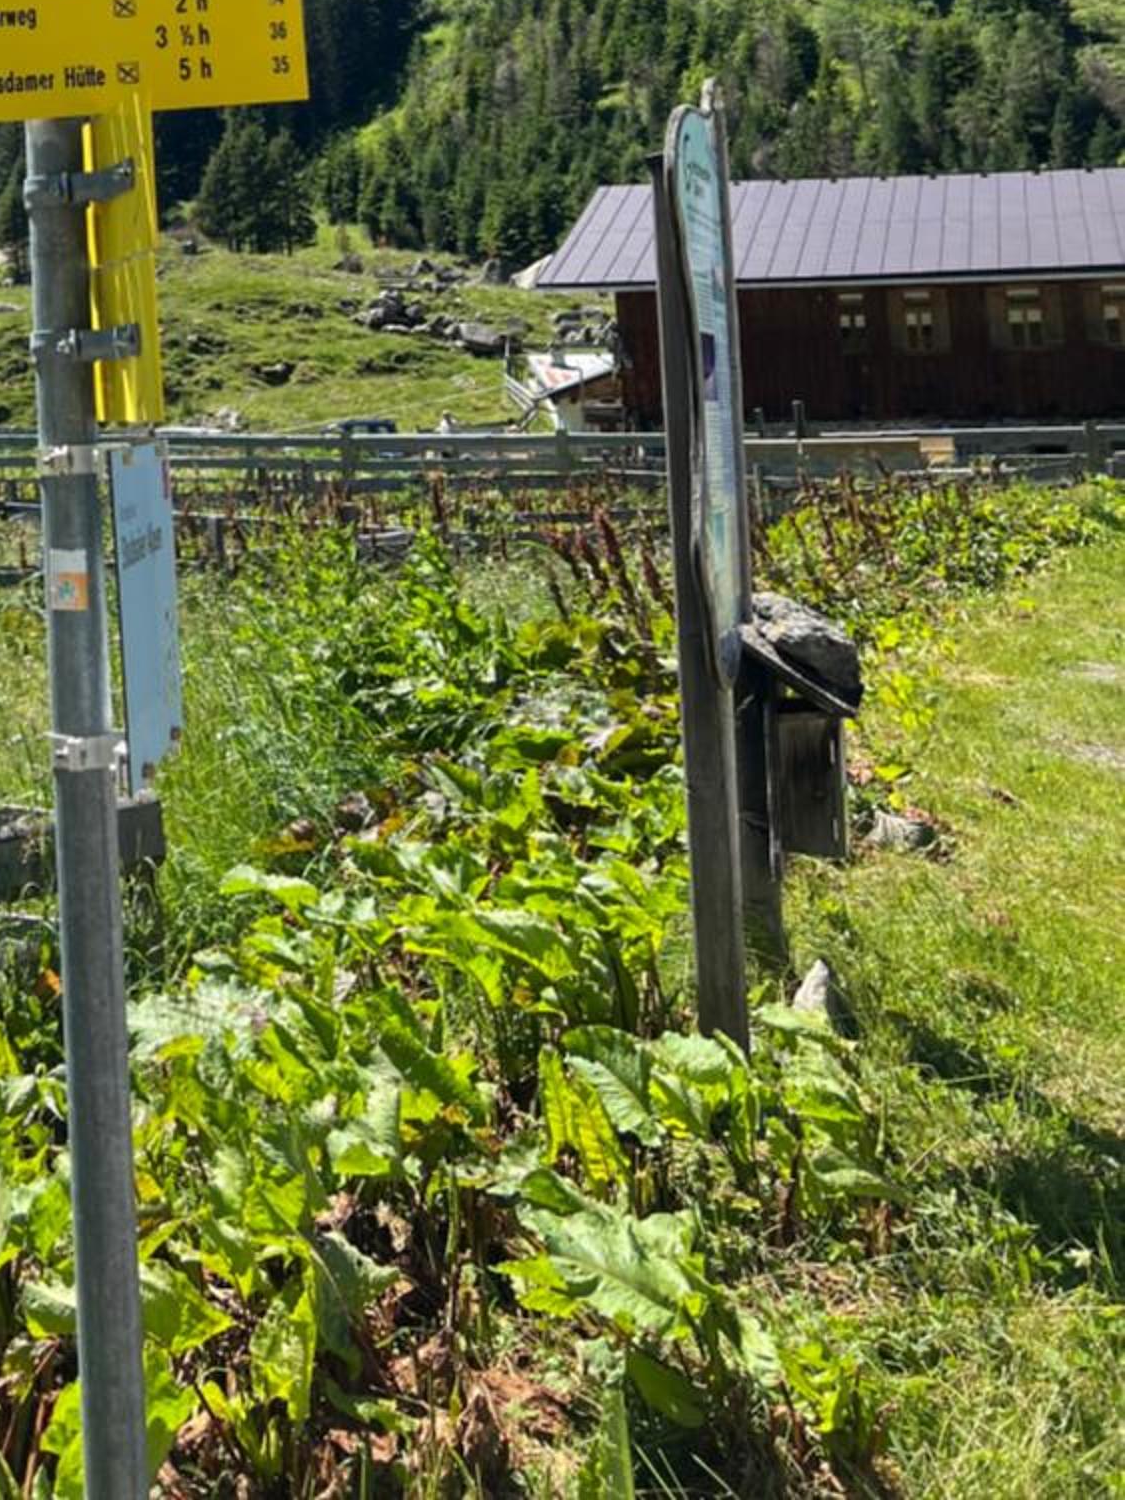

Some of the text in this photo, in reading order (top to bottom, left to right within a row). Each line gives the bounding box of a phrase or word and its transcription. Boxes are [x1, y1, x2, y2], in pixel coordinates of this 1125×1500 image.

[154, 24, 169, 50] 3
[197, 23, 211, 45] h
[63, 65, 106, 89] Hütte
[179, 57, 212, 81] 5 h
